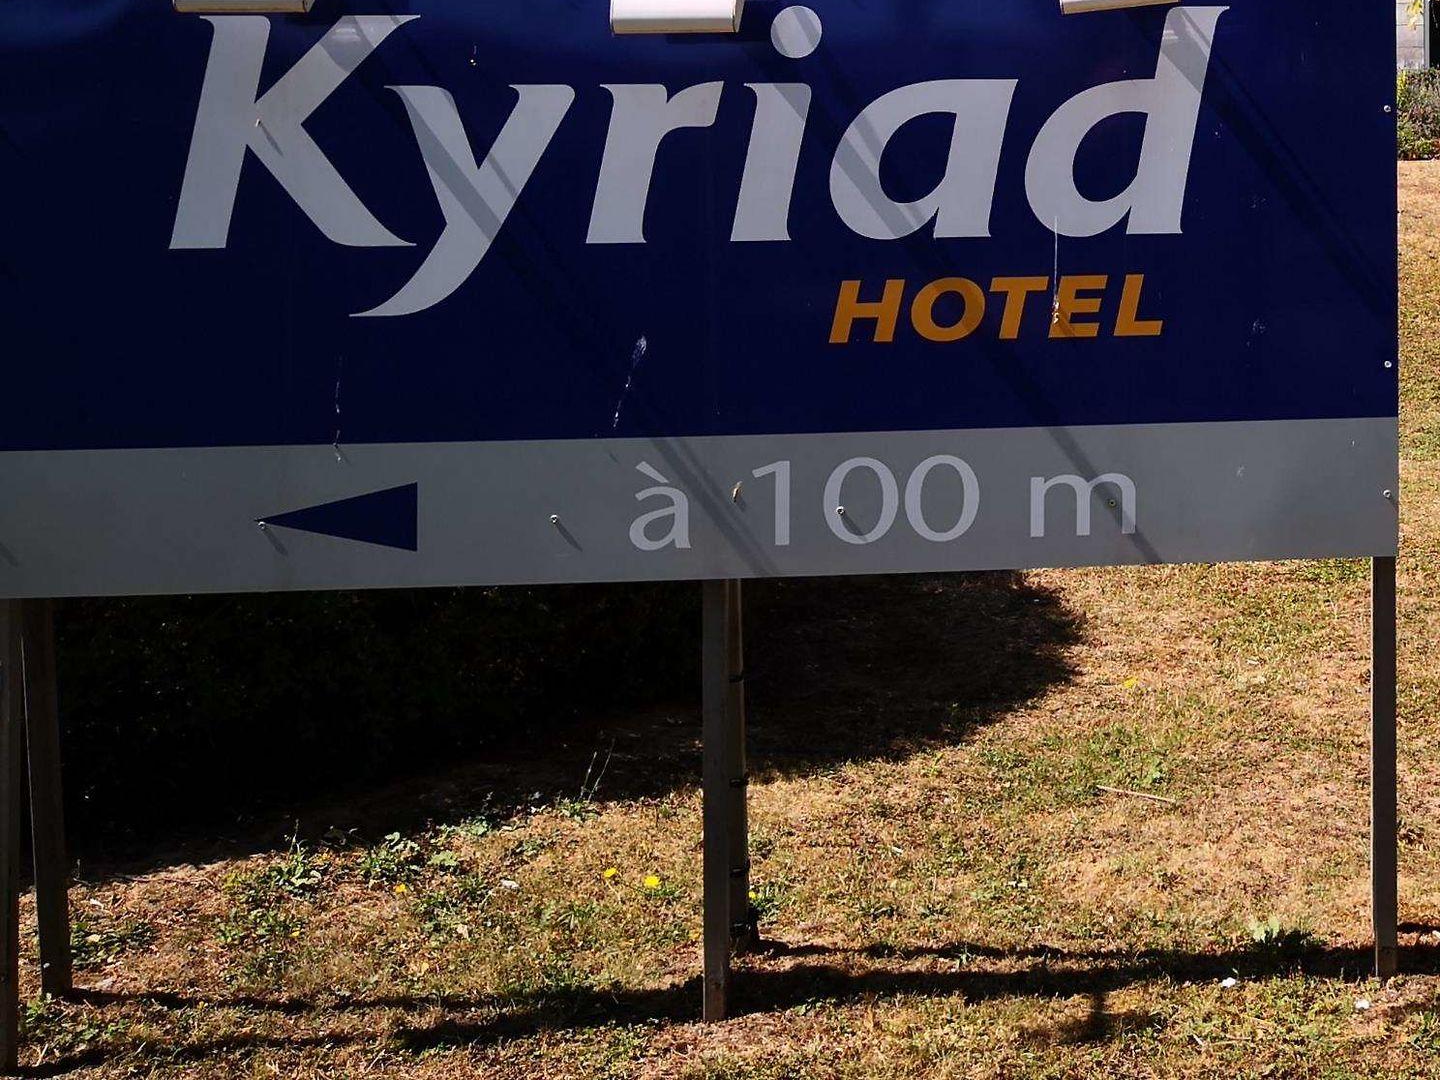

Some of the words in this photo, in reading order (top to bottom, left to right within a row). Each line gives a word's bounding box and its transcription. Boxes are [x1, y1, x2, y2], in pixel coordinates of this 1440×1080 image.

[169, 6, 1230, 317] Kyriad
[828, 274, 1164, 344] HOTEL
[629, 461, 692, 551] à
[751, 454, 980, 546] 100
[1030, 472, 1137, 538] m
